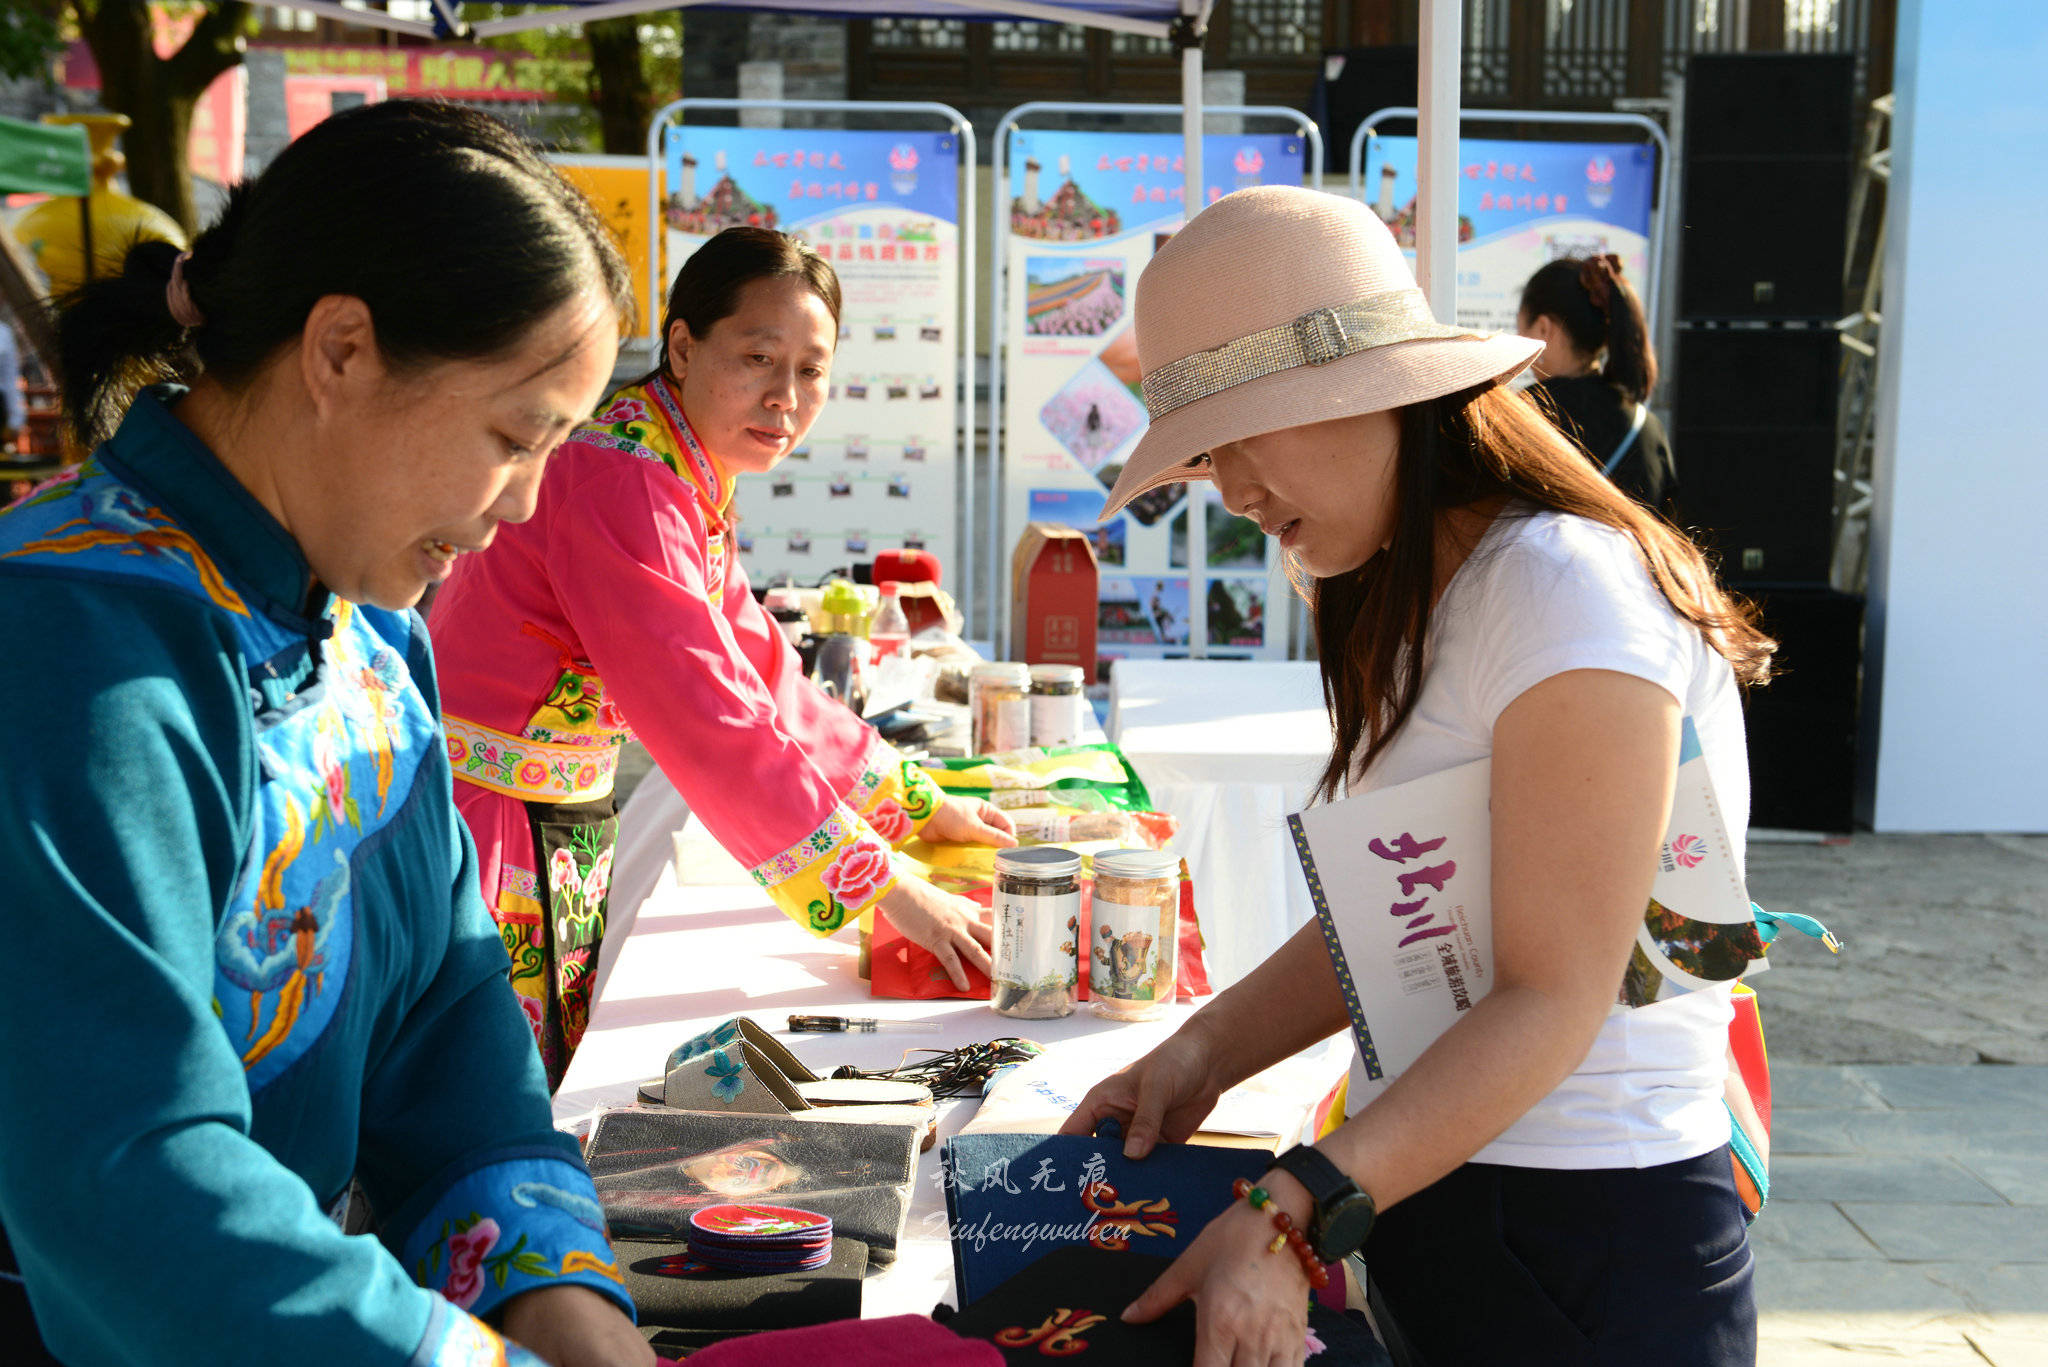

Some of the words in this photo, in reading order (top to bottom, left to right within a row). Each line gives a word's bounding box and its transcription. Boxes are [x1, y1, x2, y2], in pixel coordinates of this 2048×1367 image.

[1436, 942, 1473, 1011] 全域旅游攻略
[1470, 946, 1485, 979] County
